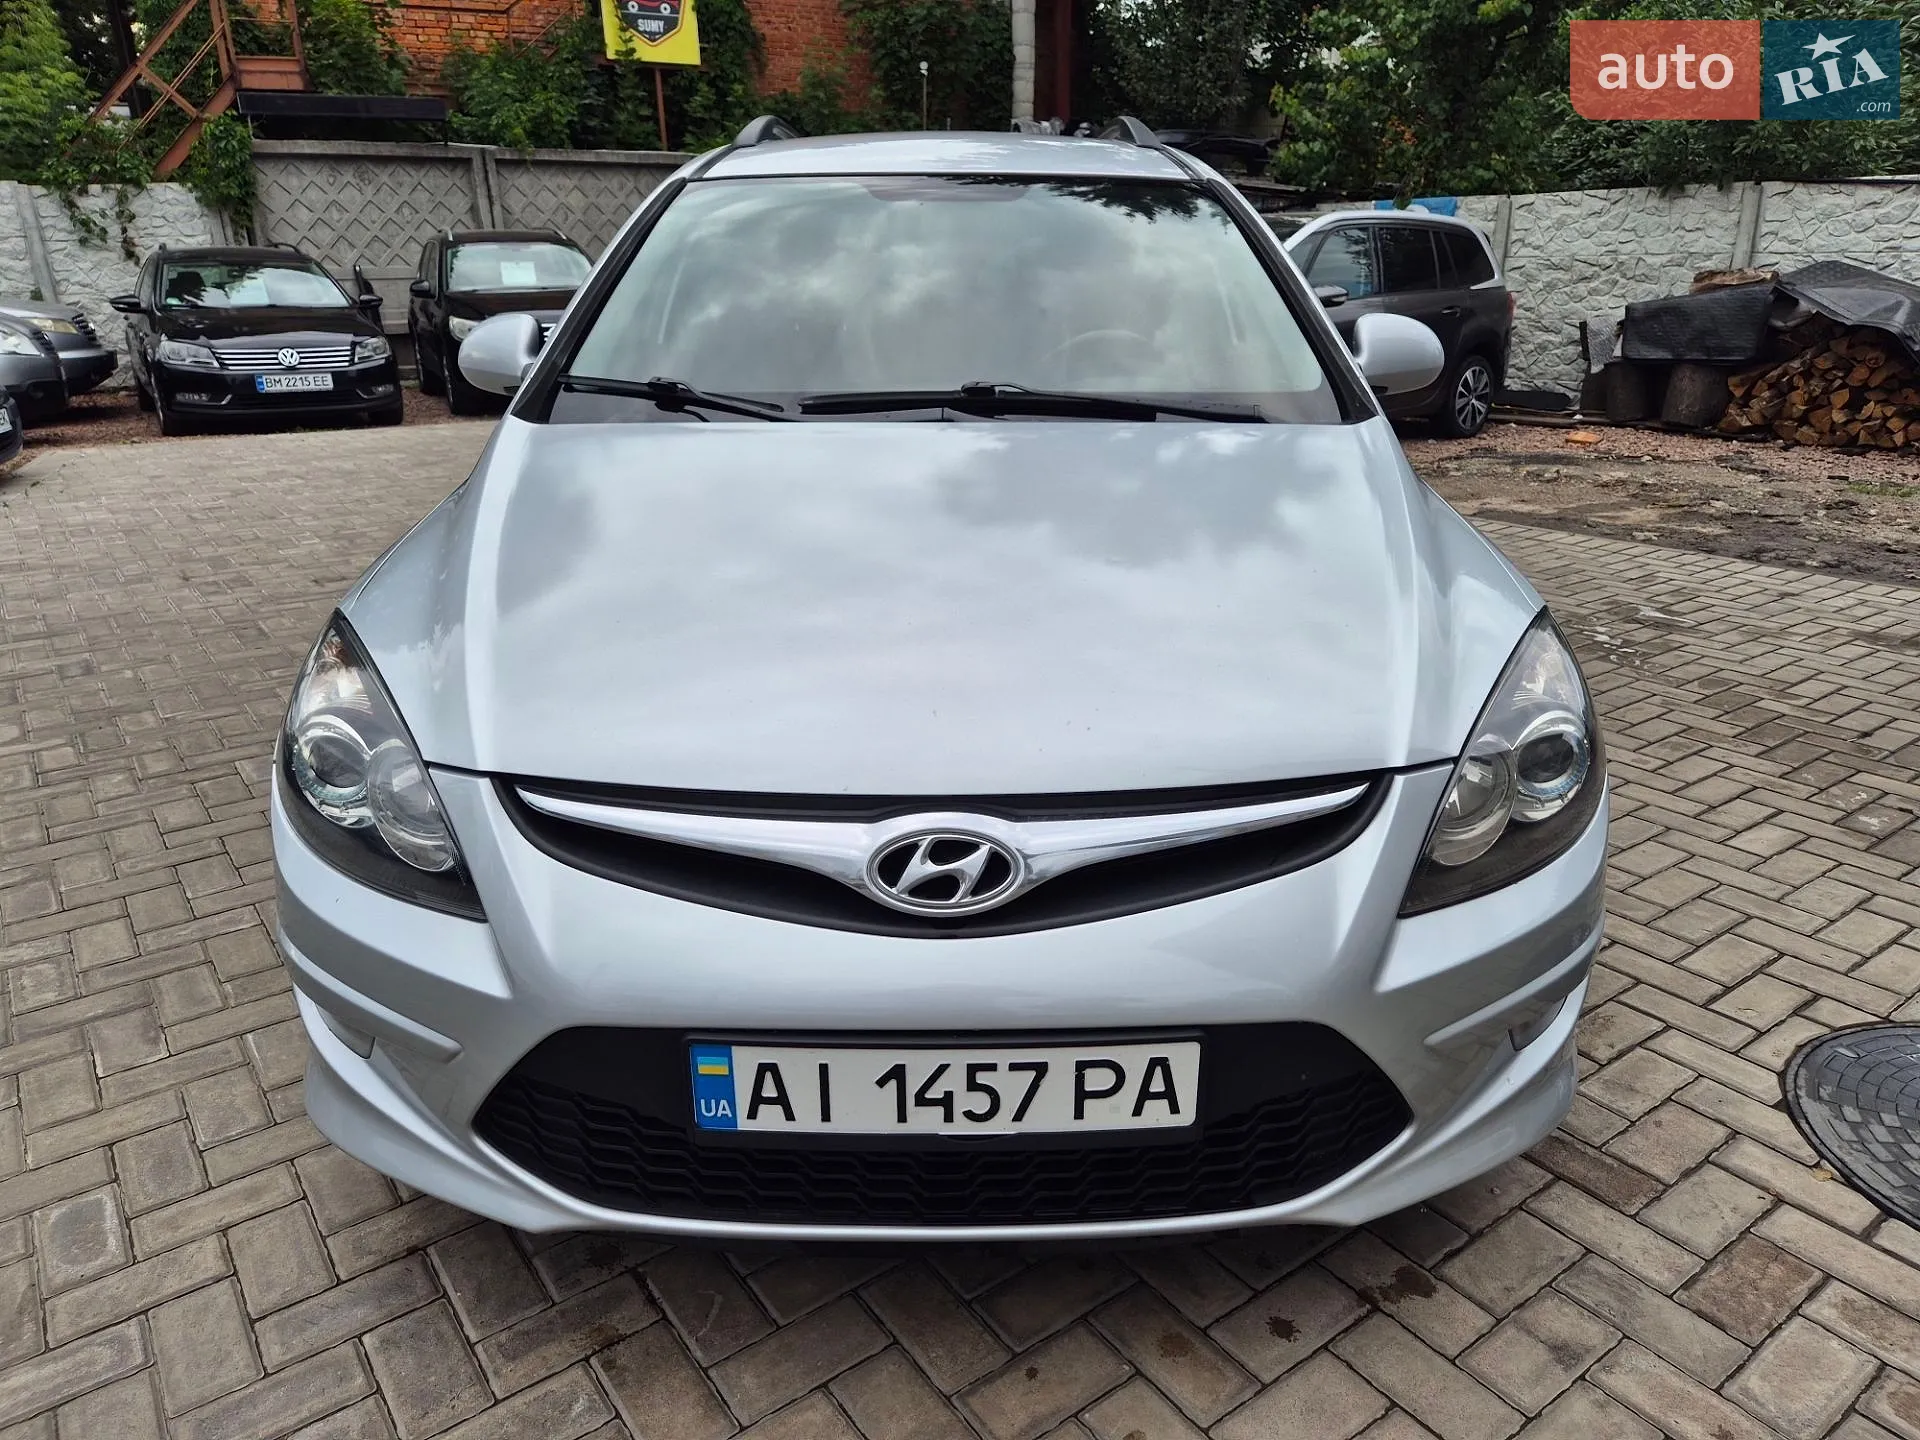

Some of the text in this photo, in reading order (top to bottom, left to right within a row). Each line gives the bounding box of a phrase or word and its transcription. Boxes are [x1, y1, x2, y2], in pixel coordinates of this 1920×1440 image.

[637, 19, 664, 33] SUMY
[265, 377, 282, 388] BM
[285, 376, 311, 387] 2215
[313, 375, 329, 387] EE
[746, 1056, 1180, 1123] AI 1457 PA
[700, 1099, 732, 1118] UA
